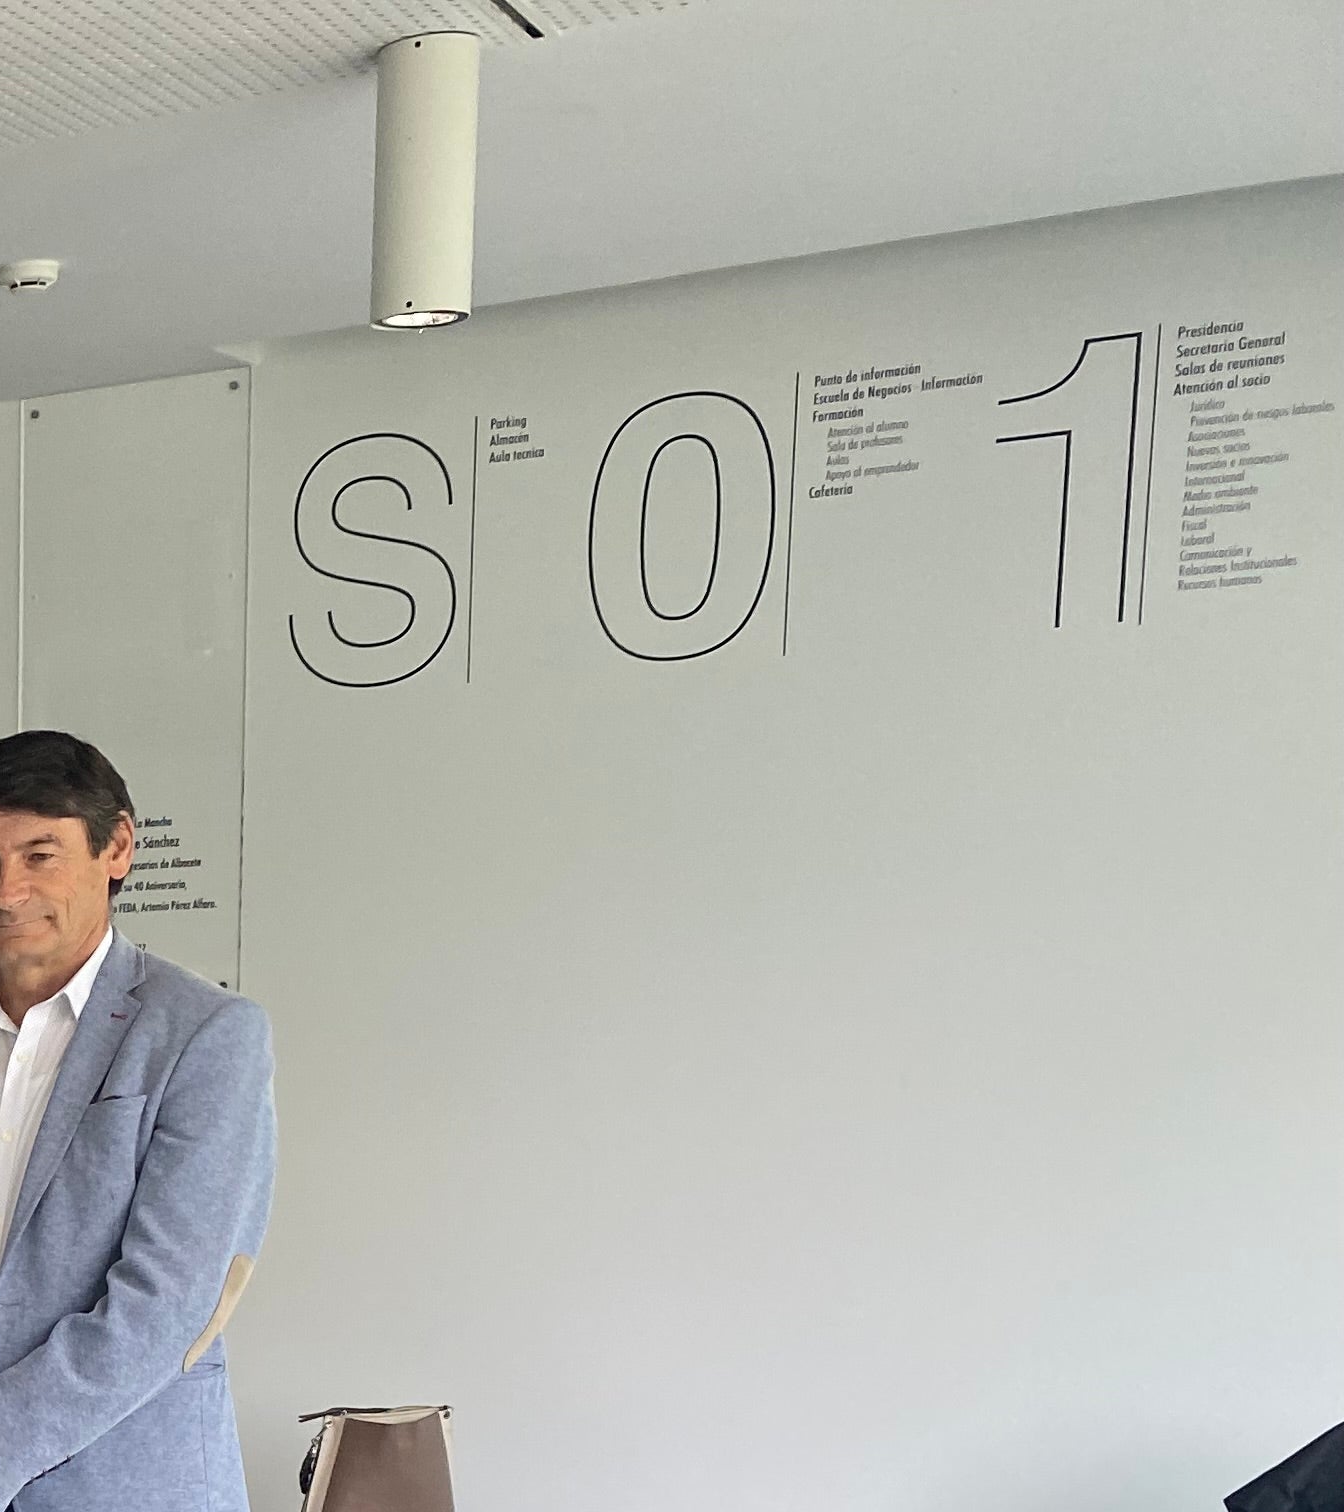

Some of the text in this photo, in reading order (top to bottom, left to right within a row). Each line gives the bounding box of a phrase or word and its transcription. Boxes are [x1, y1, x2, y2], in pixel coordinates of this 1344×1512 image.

[1177, 320, 1244, 338] Presidencia
[1238, 331, 1286, 350] General
[1174, 354, 1285, 377] Salas de reuniones
[814, 373, 842, 387] Punto
[846, 370, 857, 383] de
[1227, 375, 1238, 389] al
[1242, 374, 1271, 387] socio
[813, 389, 849, 405] Escuela
[853, 386, 864, 399] de
[868, 383, 912, 398] Negocios
[490, 416, 527, 430] Parking
[489, 450, 510, 463] Aula
[290, 432, 456, 687] S
[143, 835, 180, 849] Sánchez
